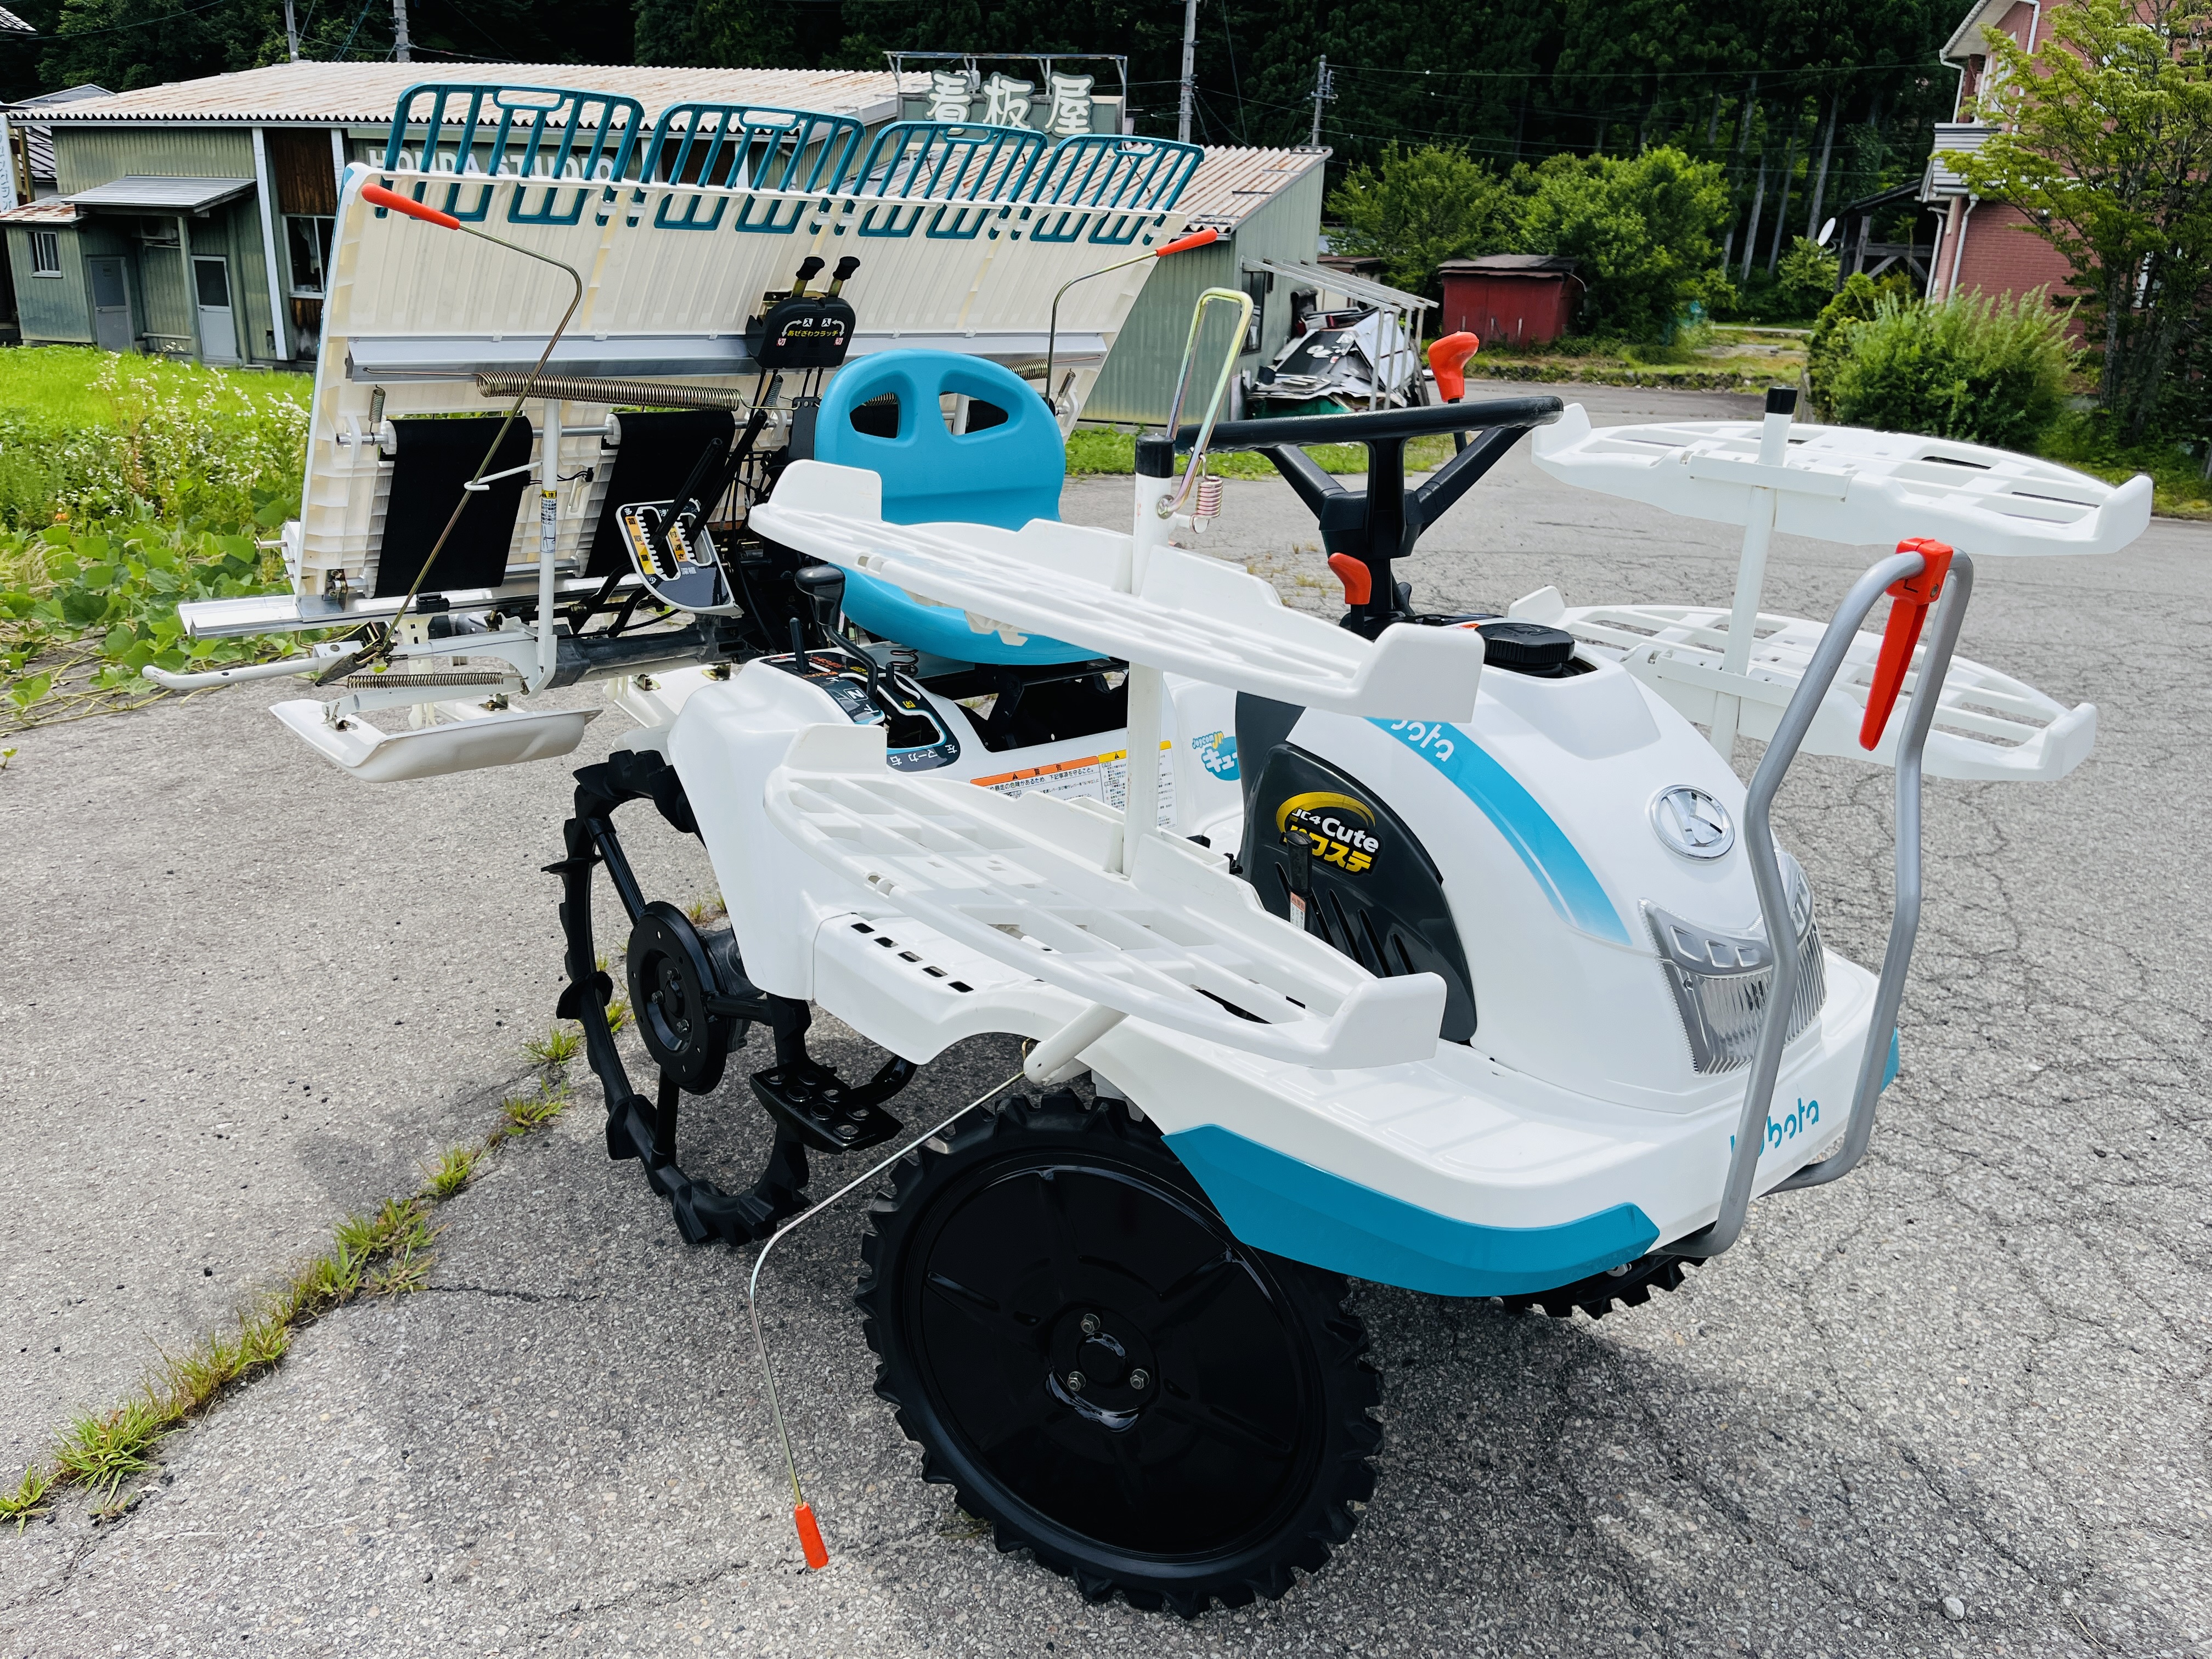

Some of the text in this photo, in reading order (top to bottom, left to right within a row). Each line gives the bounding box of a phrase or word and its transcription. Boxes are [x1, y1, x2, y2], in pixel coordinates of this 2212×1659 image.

[926, 73, 1092, 134] 看板屋
[1291, 808, 1379, 853] JC4 Cute
[1730, 1098, 1819, 1158] bota
